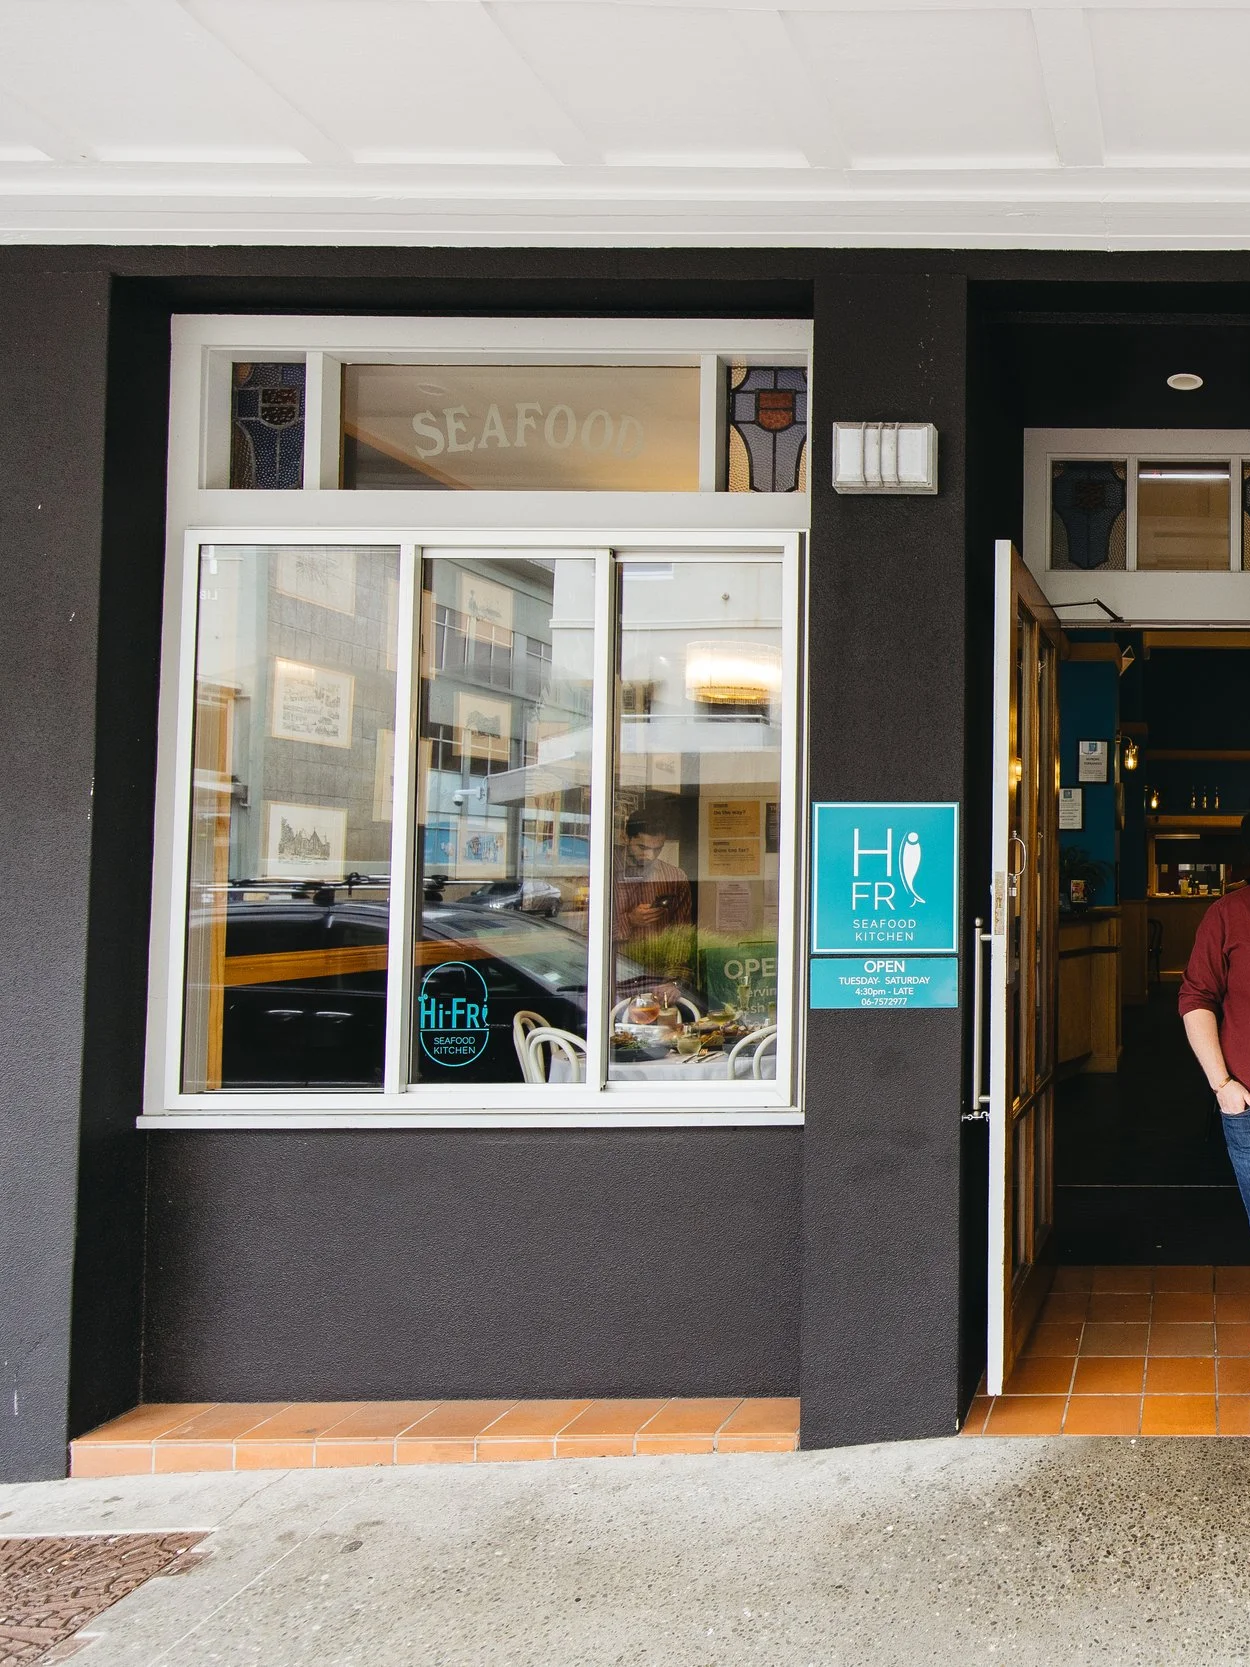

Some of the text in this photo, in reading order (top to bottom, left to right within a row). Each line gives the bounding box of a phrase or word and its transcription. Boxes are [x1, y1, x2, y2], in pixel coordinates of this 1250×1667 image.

[412, 401, 645, 460] SEAFOOD
[853, 919, 917, 929] SEAFOOD
[855, 932, 914, 941] KITCHEN
[864, 960, 905, 973] OPEN
[885, 976, 930, 985] SATURDAY
[855, 987, 886, 996] 4:30pm
[893, 987, 914, 995] LATE
[861, 998, 907, 1006] 06-7572977
[434, 1037, 475, 1045] SEAFOOD
[433, 1046, 476, 1055] KITCHEN
